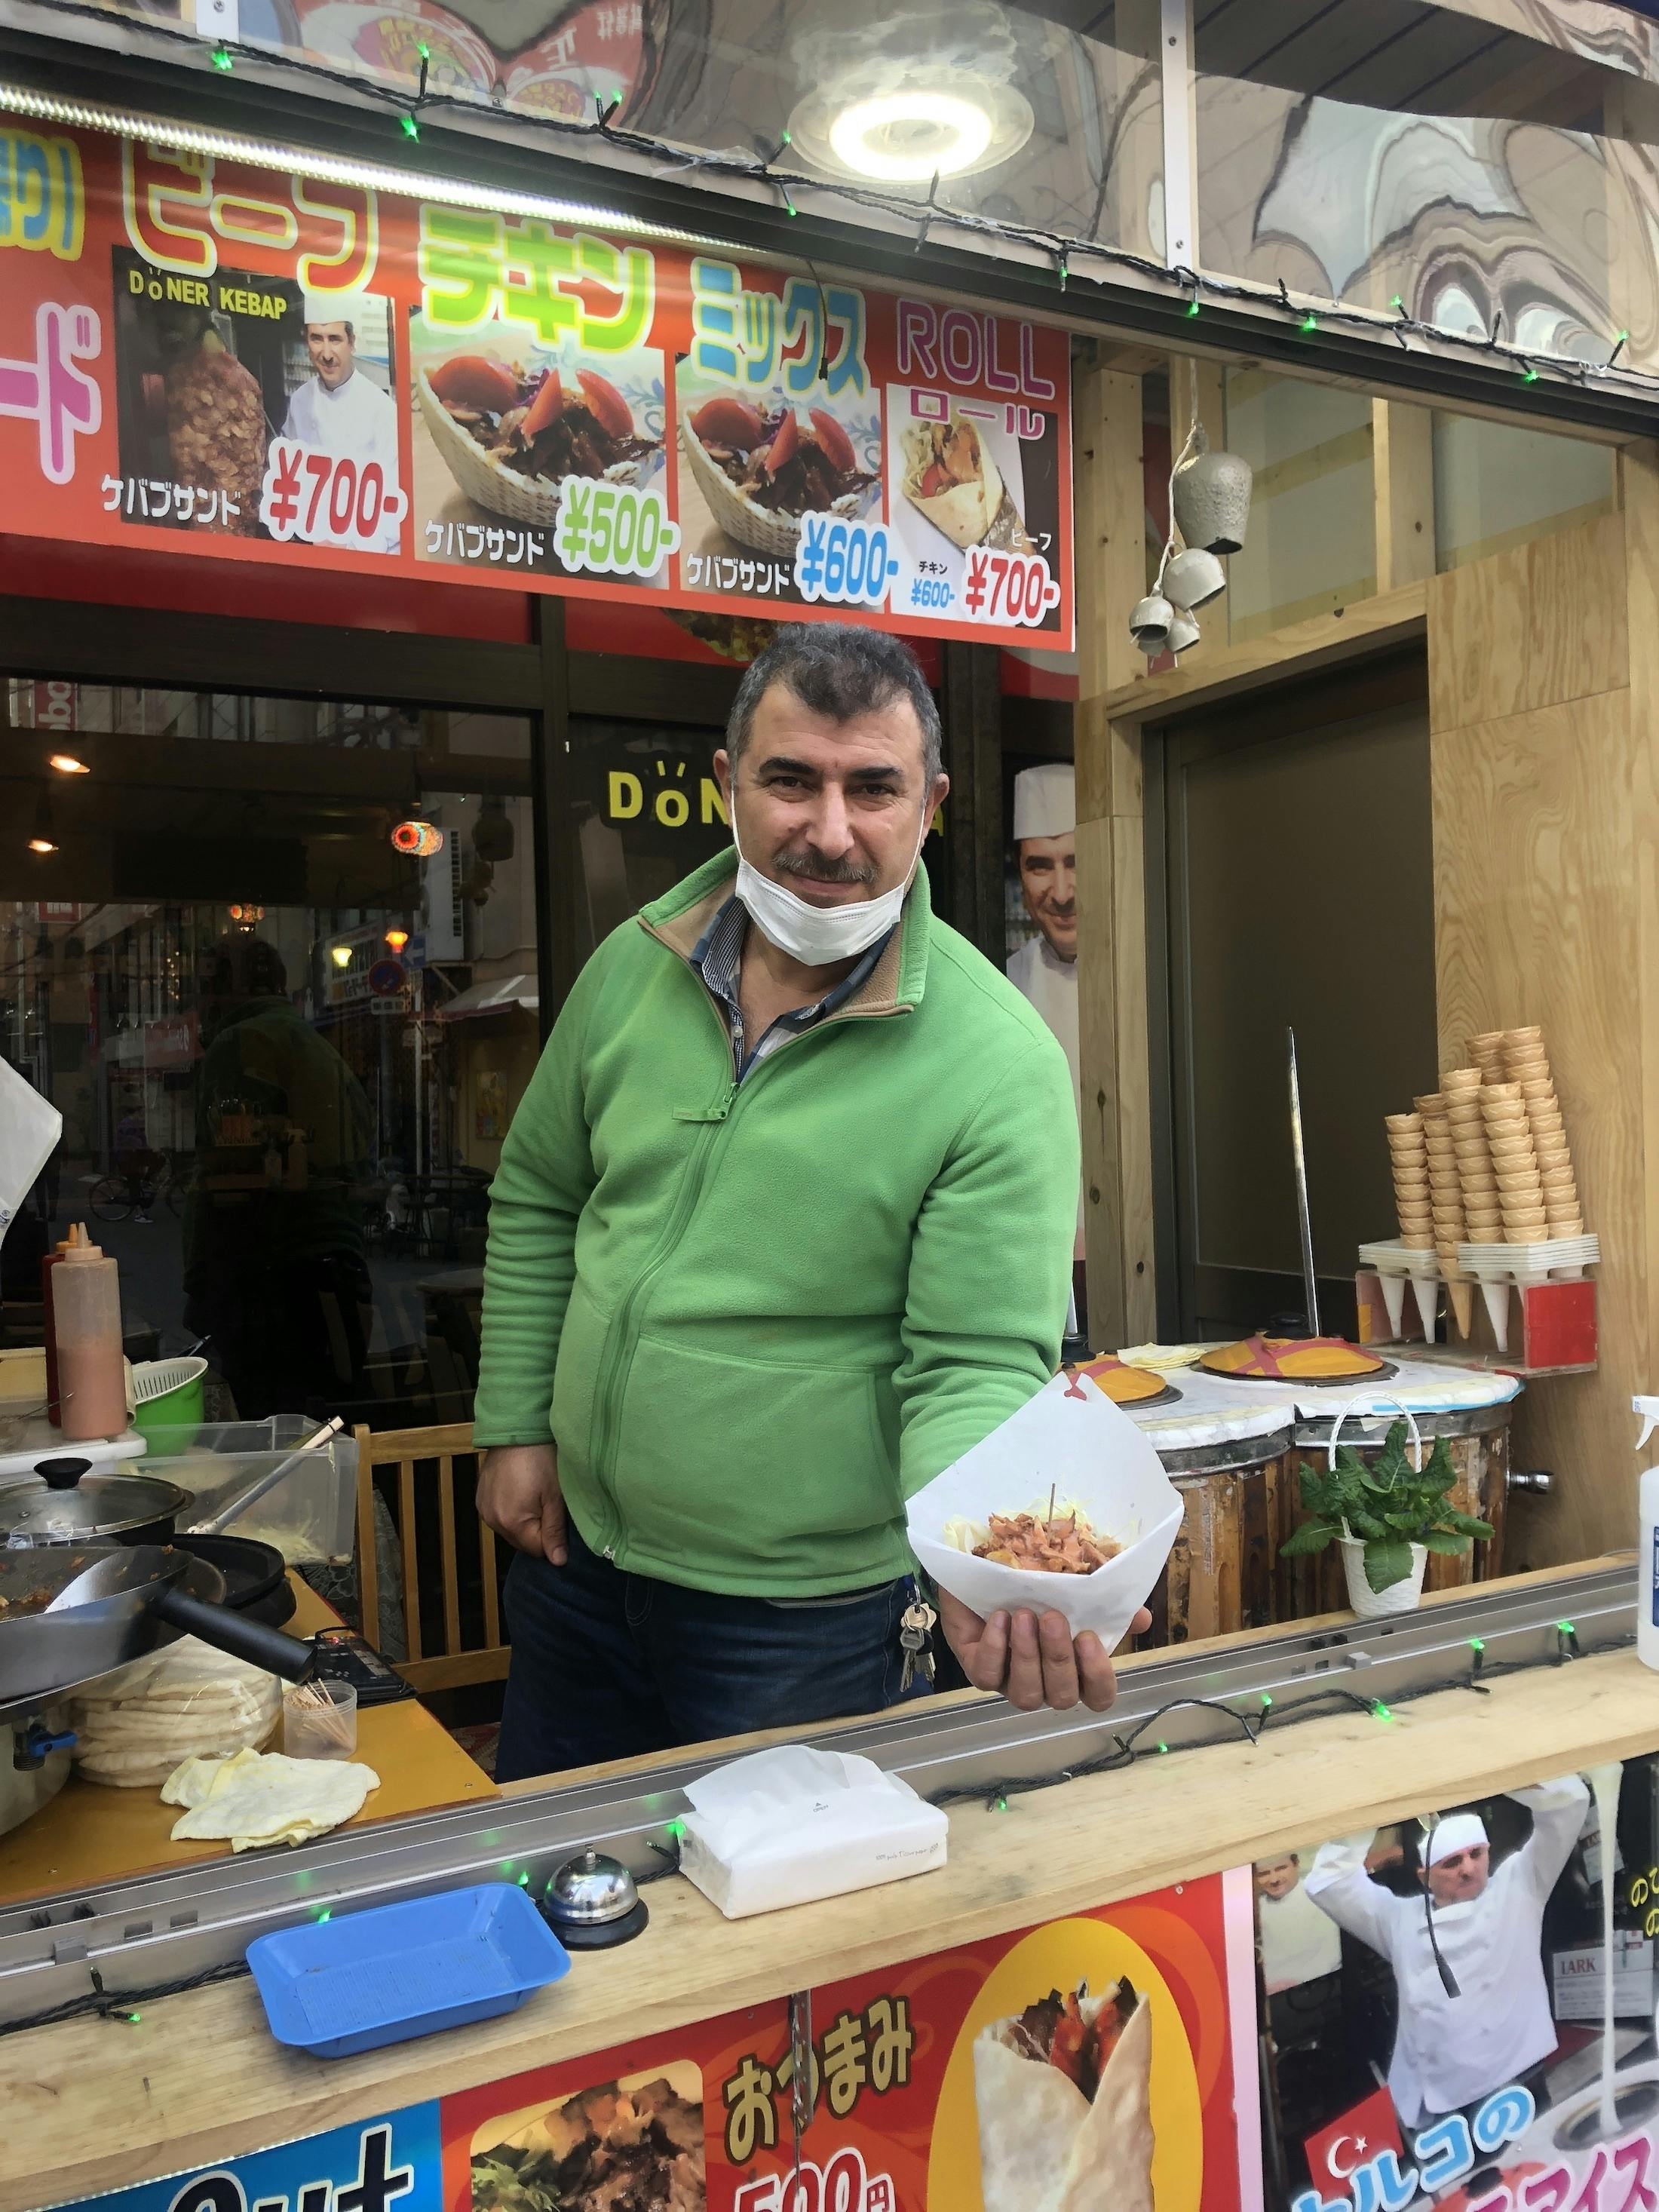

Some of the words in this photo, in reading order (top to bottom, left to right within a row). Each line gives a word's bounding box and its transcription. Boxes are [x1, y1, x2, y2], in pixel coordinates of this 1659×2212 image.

[124, 138, 379, 294] ビーフ
[219, 287, 287, 320] KEBAP
[422, 207, 652, 351] チキン
[695, 259, 869, 400] ミックス
[896, 297, 1056, 400] ROLL
[909, 385, 1045, 440] ロール
[101, 474, 241, 526] ケバブサンド
[425, 519, 544, 566] ケバブサンド
[918, 560, 949, 575] チキン
[686, 553, 790, 596] ケバブサンド
[725, 1999, 912, 2164] おつまみ
